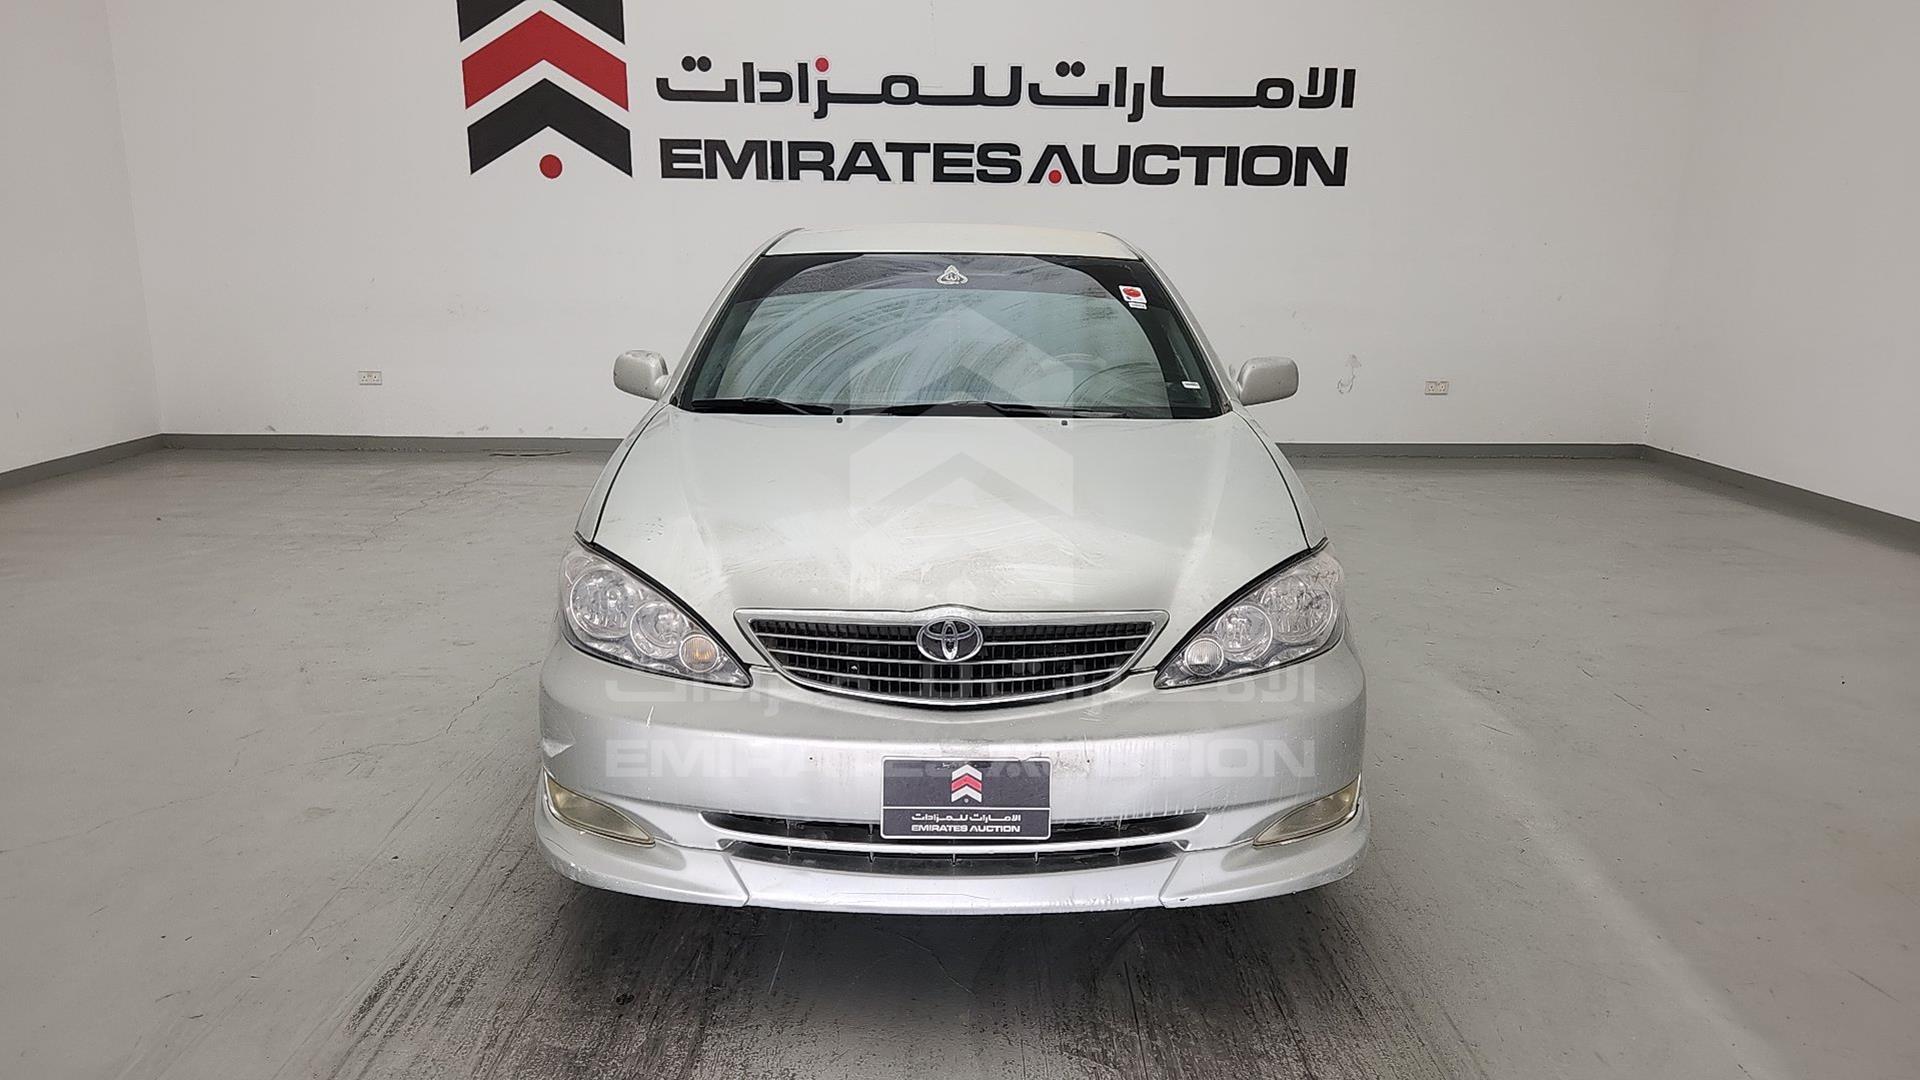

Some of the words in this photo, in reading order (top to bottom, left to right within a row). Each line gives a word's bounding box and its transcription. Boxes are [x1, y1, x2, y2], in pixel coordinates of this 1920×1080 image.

[656, 55, 1022, 119] للمزادات
[1028, 60, 1356, 123] الامارات
[659, 138, 1022, 184] EMIRATES
[1027, 144, 1349, 187] AUCTION
[911, 824, 968, 833] EMIRATES
[969, 825, 1021, 833] AUCTION
